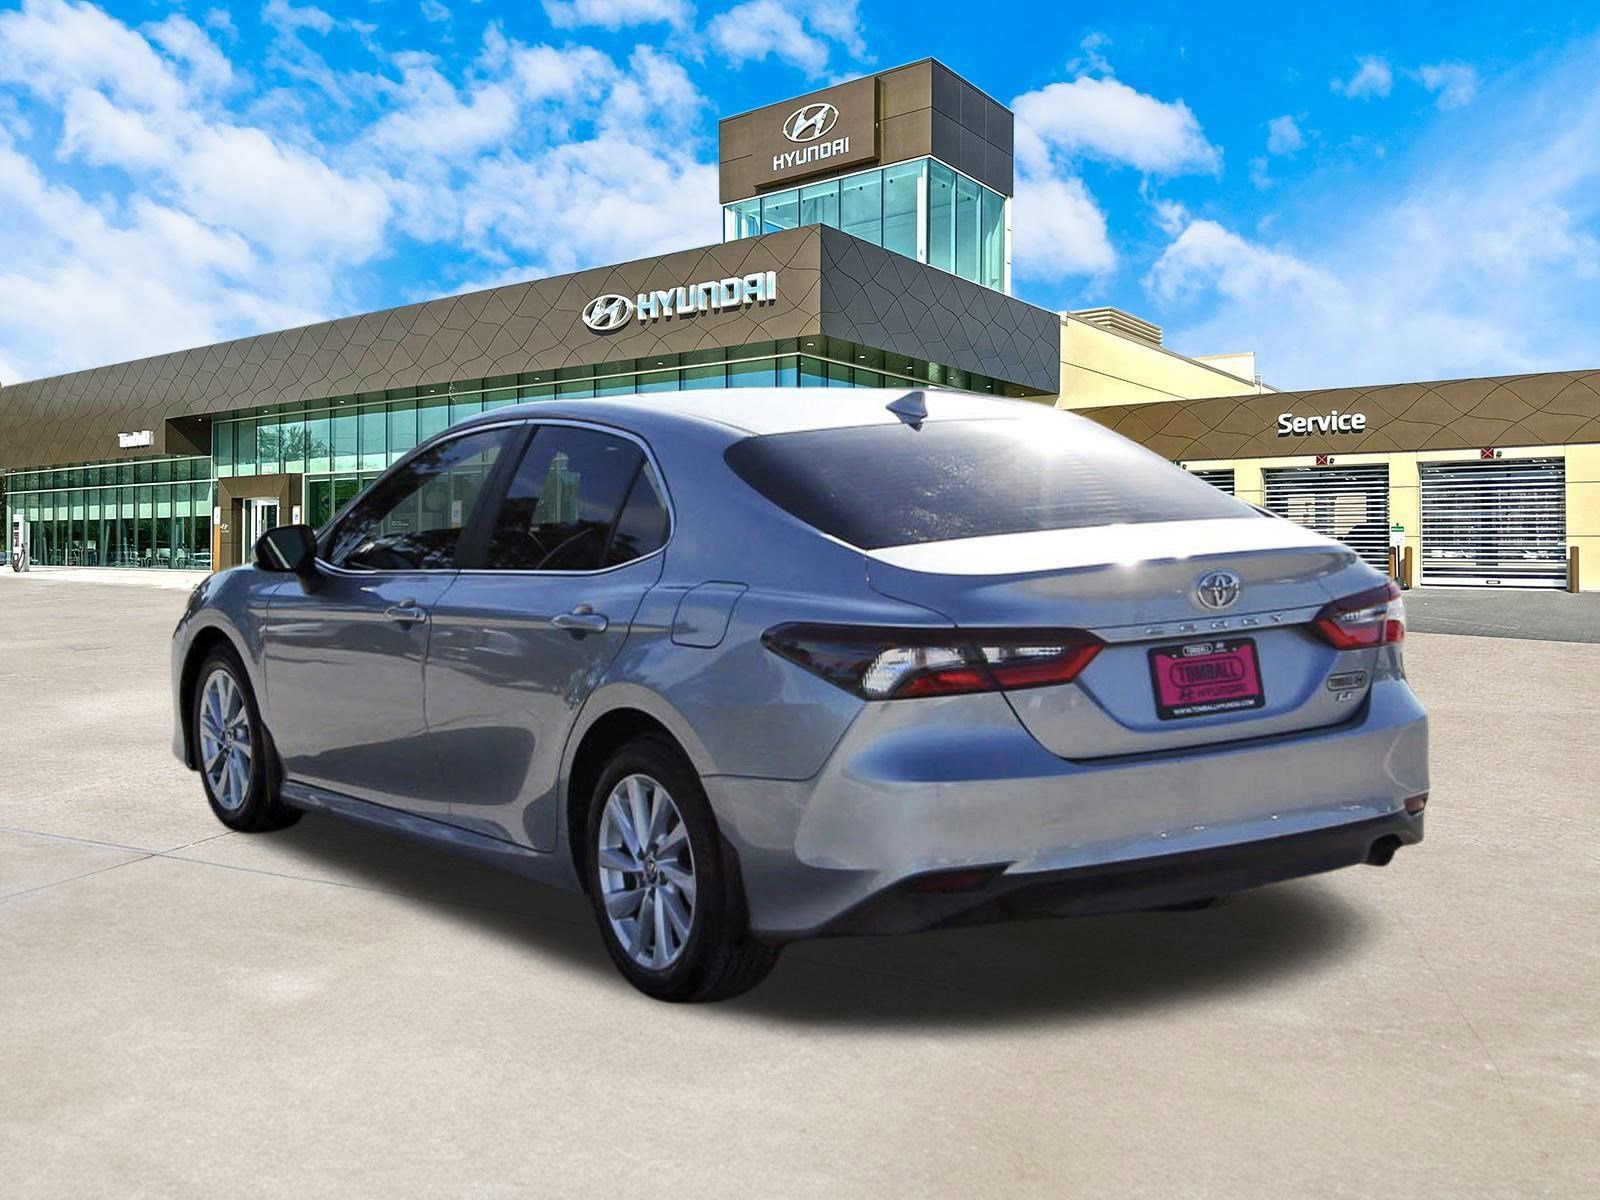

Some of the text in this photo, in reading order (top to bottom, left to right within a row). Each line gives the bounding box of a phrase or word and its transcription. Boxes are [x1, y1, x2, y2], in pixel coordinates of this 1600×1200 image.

[773, 136, 850, 171] HYUNDAI
[636, 270, 777, 321] HYUNDAI
[1277, 410, 1367, 435] Service
[1176, 660, 1239, 683] TOMBALL
